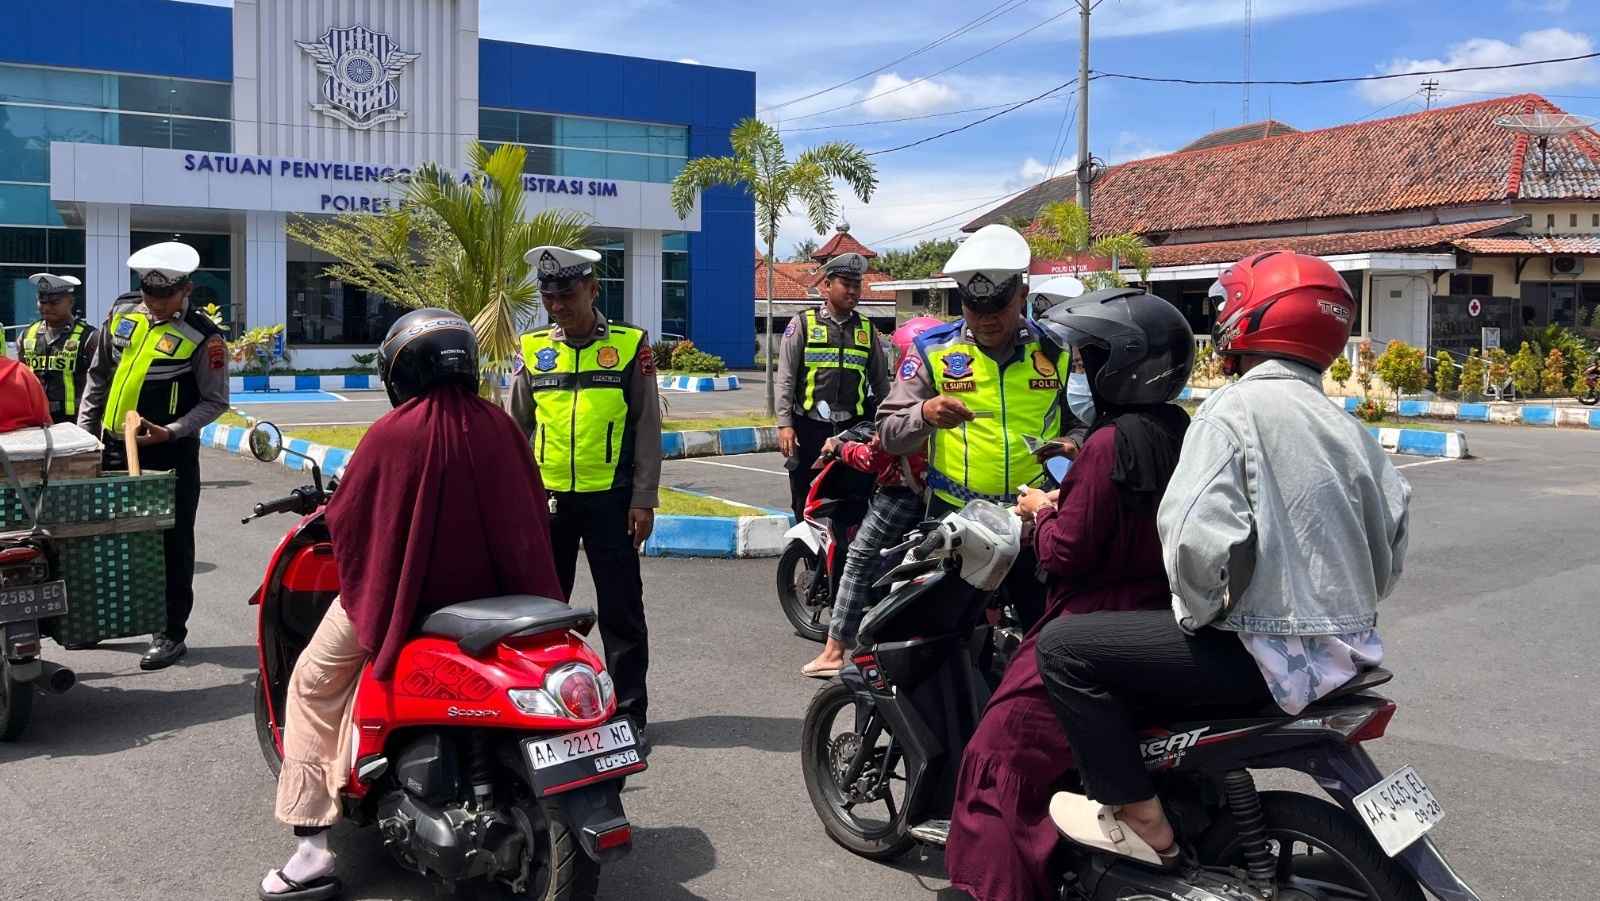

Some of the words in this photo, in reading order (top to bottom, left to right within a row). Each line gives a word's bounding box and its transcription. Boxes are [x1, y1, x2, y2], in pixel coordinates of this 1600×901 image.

[185, 154, 272, 176] SATUAN
[588, 181, 617, 197] SIM
[535, 746, 557, 764] AA
[564, 733, 602, 757] 2212
[611, 725, 631, 745] NC
[1363, 800, 1386, 826] AA
